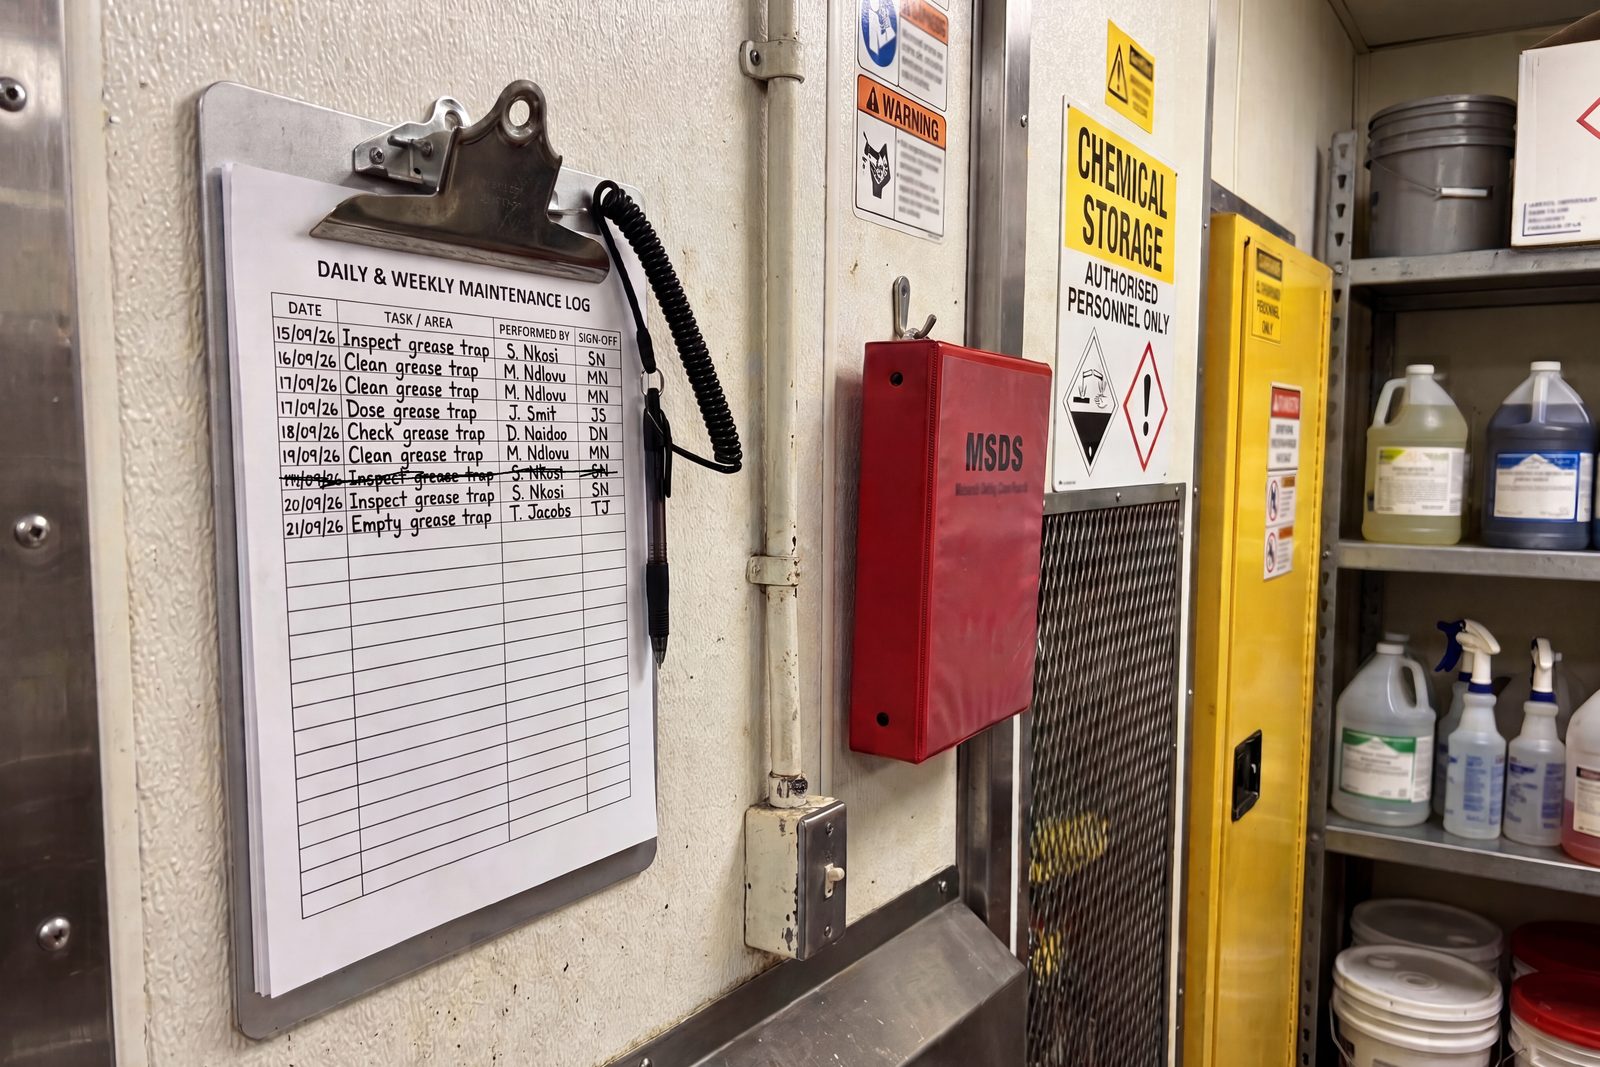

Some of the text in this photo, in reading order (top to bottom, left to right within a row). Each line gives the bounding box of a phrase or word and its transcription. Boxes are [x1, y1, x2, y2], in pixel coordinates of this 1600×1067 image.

[883, 93, 939, 142] WARNING
[1078, 126, 1167, 220] CHEMICAL
[1082, 194, 1163, 273] STORAGE
[318, 260, 590, 312] DAILY & WEEKLY MAINTENANCE LOG
[1085, 261, 1158, 305] AUTHORISED
[289, 302, 322, 316] DATE
[384, 312, 453, 329] TASK / AREA
[1068, 286, 1170, 335] PERSONNEL ONLY
[277, 324, 605, 366] 15/09/26 Inspect grease trap S. Nkosi SN
[499, 324, 569, 341] PERFORMED BY
[578, 332, 617, 346] SIGN-OFF
[279, 349, 608, 385] 16/09/26 Clean grease trap M. Ndlovu MN
[280, 374, 608, 404] 17/09/26 Clean grease trap M. Ndlovu MN
[281, 399, 606, 426] 17/09/26 Dose grease trap J. Smit JS
[282, 422, 608, 448] 18/09/26 Check grease trap D. Naidoo DN
[966, 432, 1023, 472] MSDS
[283, 444, 609, 470] 19/09/26 Clean grease trap M. Ndlovu MN
[284, 482, 609, 514] 20/09/26 Inspect grease trap S. Nkosi SN
[286, 500, 610, 538] 21/09/26 Empty grease trap T. Jacobs TJ
